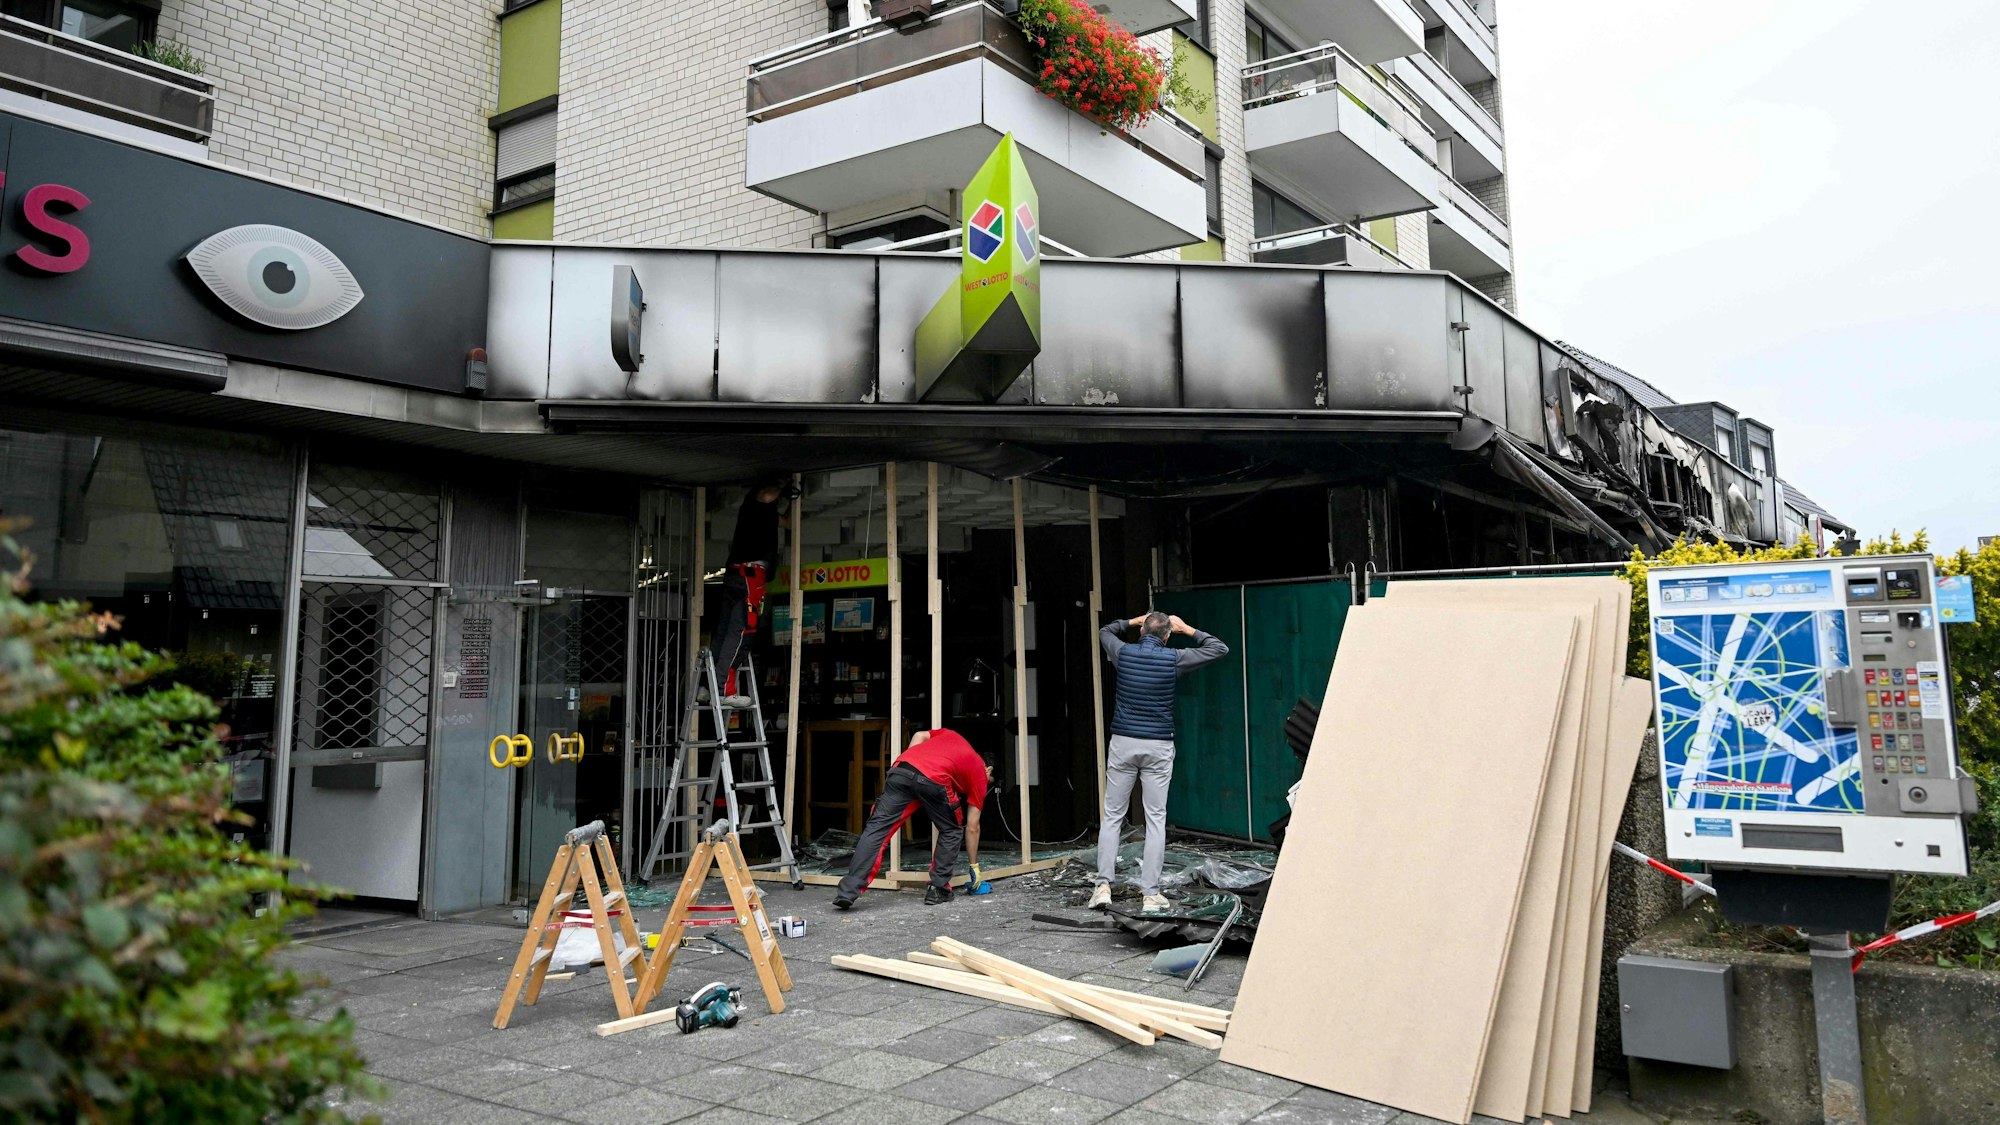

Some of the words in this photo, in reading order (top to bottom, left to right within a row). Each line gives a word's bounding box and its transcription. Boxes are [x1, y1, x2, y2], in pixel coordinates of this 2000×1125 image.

[0, 171, 92, 273] S
[965, 279, 981, 292] WEST
[987, 272, 1008, 285] LOTTO
[780, 568, 815, 586] WST
[827, 565, 870, 583] LOTTO
